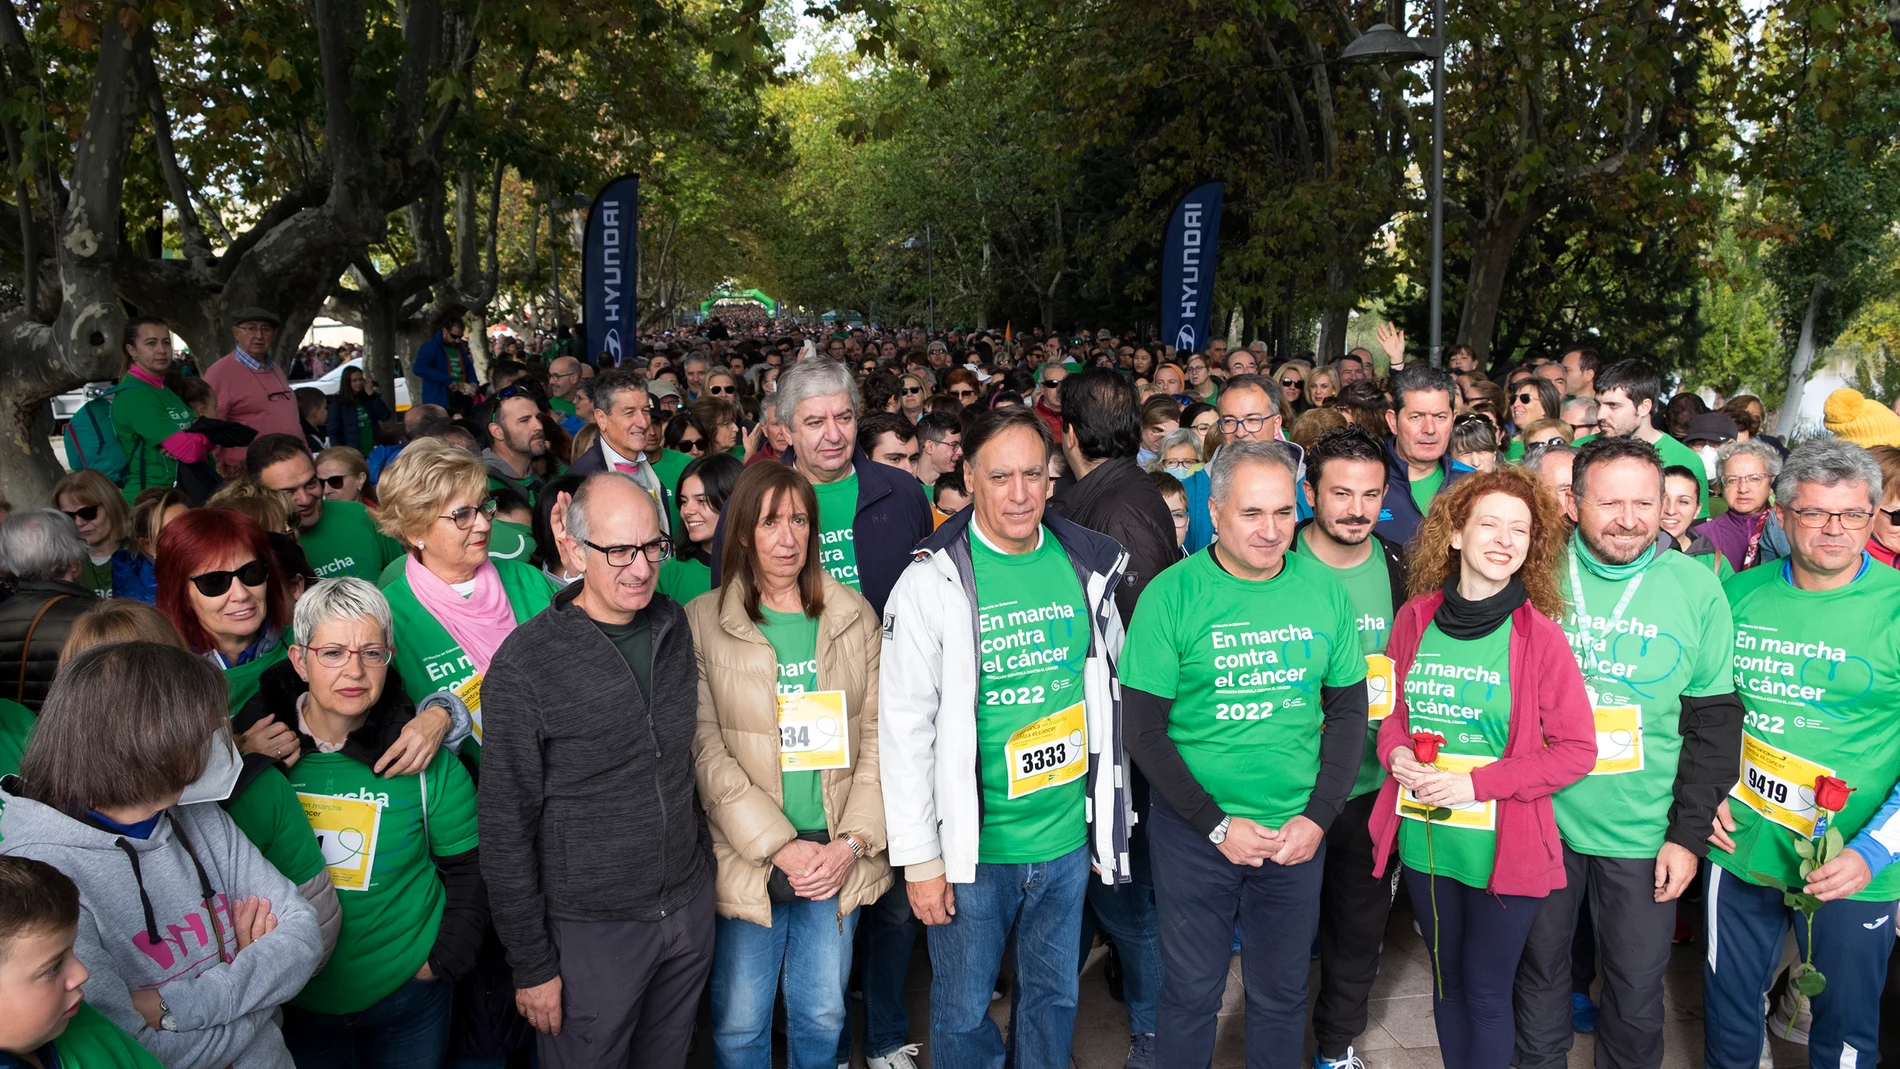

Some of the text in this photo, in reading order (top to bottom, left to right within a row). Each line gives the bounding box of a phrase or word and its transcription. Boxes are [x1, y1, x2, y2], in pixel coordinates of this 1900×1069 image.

[603, 200, 621, 322] HYUNDAI
[1181, 203, 1202, 318] HYUNDAI
[314, 556, 355, 577] archa
[819, 548, 844, 563] tra
[979, 601, 1075, 633] En marcha
[1356, 614, 1385, 631] cha
[980, 628, 1046, 654] contra
[1211, 623, 1314, 649] En marcha
[1735, 630, 1847, 662] En marcha
[982, 646, 1069, 673] el cáncer
[1214, 648, 1279, 670] contra
[1733, 655, 1795, 676] contra
[425, 662, 456, 682] En
[1214, 667, 1307, 688] el cáncer
[1424, 665, 1501, 686] marcha
[776, 681, 805, 695] tra
[985, 685, 1046, 705] 2022
[1733, 672, 1826, 701] el cáncer
[1215, 701, 1274, 720] 2022
[1416, 698, 1483, 721] cáncer
[1022, 743, 1066, 774] 3333
[1748, 767, 1788, 804] 9419
